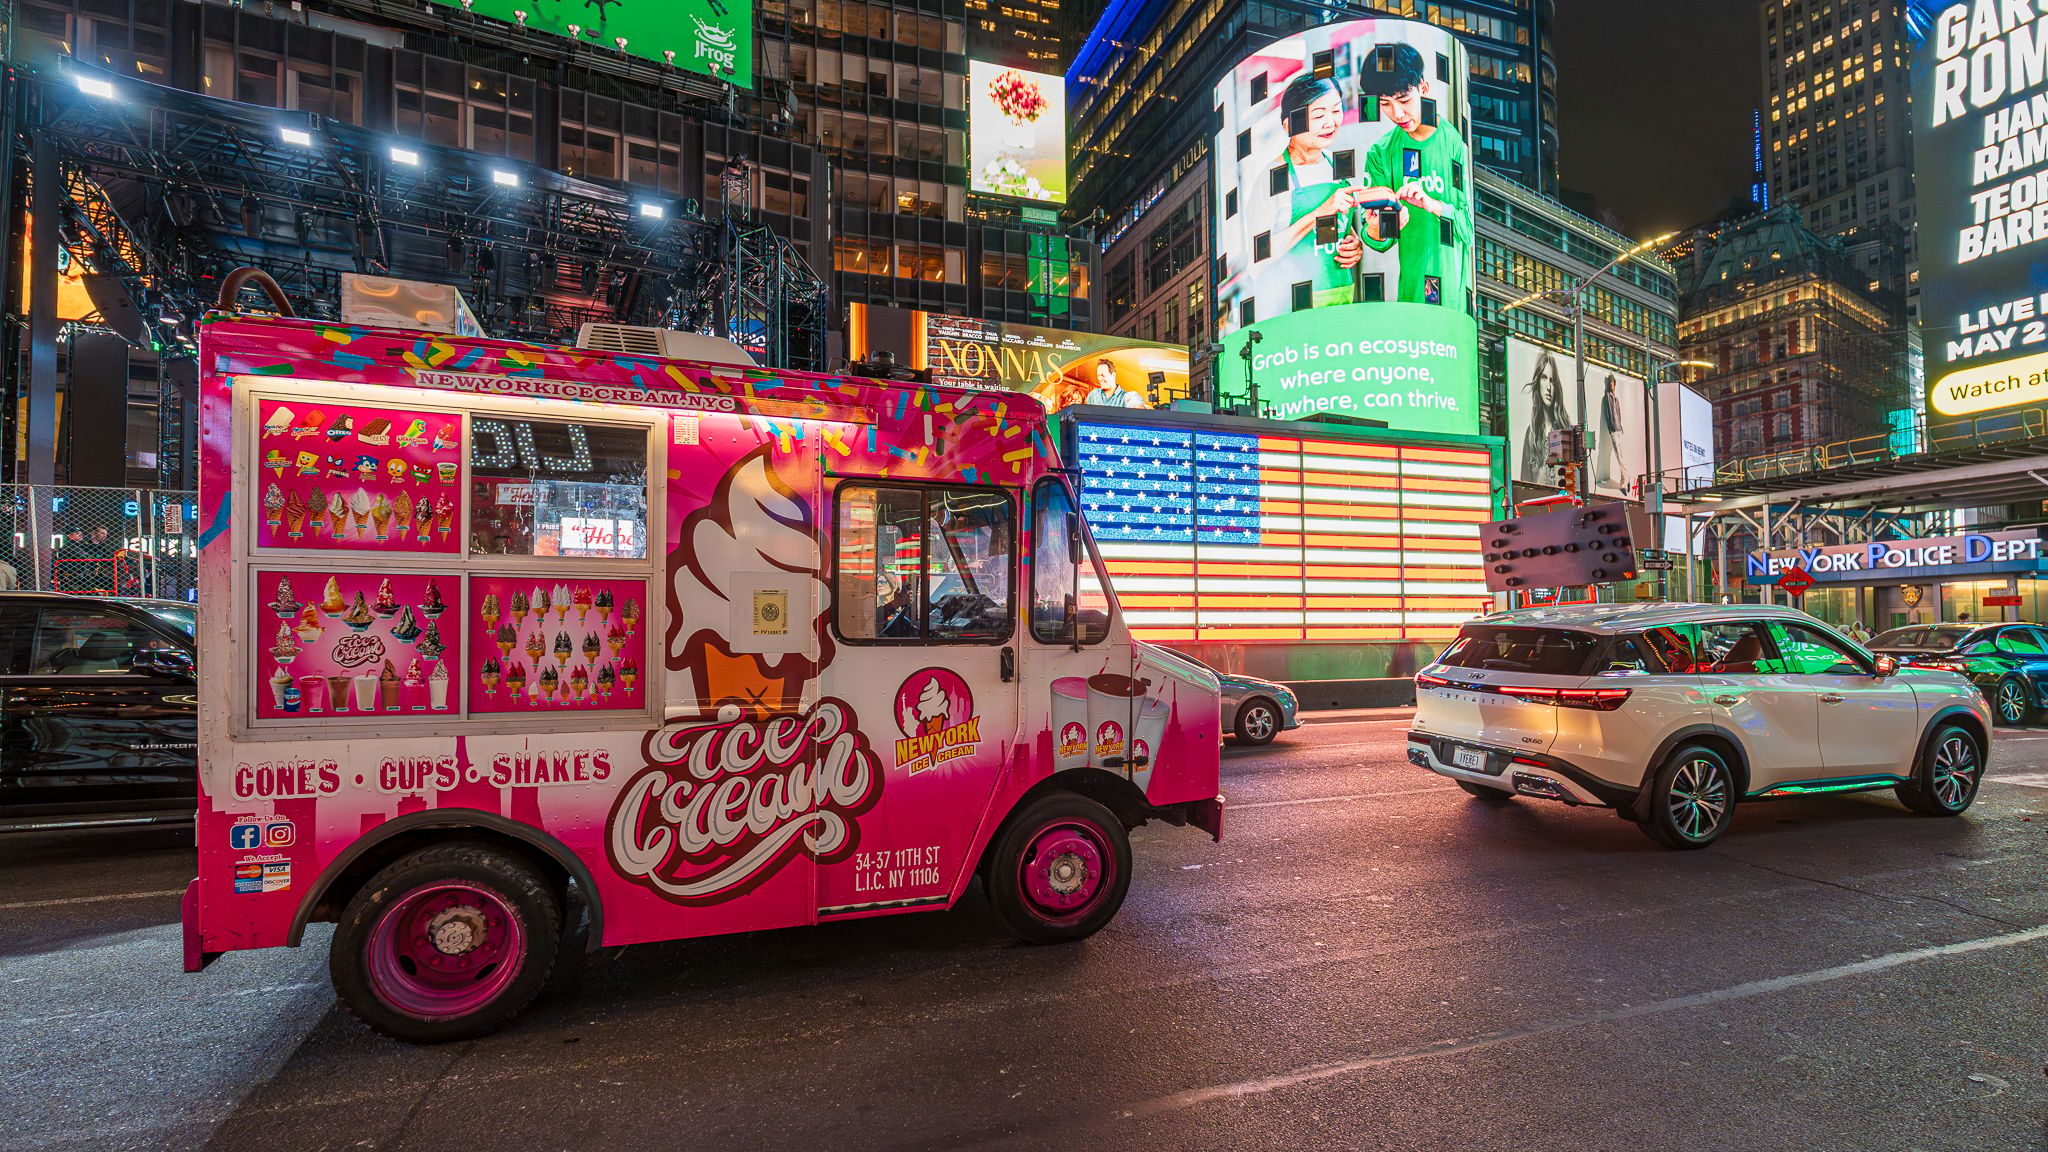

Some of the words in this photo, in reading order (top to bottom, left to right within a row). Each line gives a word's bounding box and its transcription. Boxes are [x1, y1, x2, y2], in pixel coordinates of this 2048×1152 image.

[1936, 0, 2048, 60] GAR
[694, 40, 734, 68] JFrog
[1960, 297, 2034, 334] LIVE
[1252, 346, 1298, 371] Grab
[1304, 343, 1319, 360] is
[1325, 340, 1353, 358] an
[1359, 339, 1457, 359] ecosystem
[1947, 327, 2017, 362] MAY
[2022, 321, 2046, 345] 2
[939, 340, 1064, 385] NONNAS
[418, 372, 733, 409] NEWYORKICECREAM.NYC
[939, 378, 956, 387] Your
[957, 380, 975, 389] table
[1280, 368, 1346, 390] where
[1351, 366, 1435, 385] anyone,
[1950, 375, 2021, 400] Watch
[1258, 392, 1359, 420] nywhere,
[1364, 391, 1402, 408] can
[1407, 389, 1460, 412] thrive.
[165, 506, 173, 532] NATIONAL
[1798, 548, 1861, 573] YORK
[1868, 543, 1953, 569] POLICE
[1965, 535, 2043, 563] DEPT
[1521, 736, 1543, 745] QX60
[911, 758, 930, 773] ICE
[937, 745, 974, 762] CREAM
[235, 758, 340, 799] CONES
[379, 754, 460, 791] CUPS
[492, 748, 611, 786] SHAKES
[257, 854, 282, 862] Accept
[855, 851, 891, 872] 34-37
[895, 848, 920, 868] 11TH
[924, 846, 940, 863] ST
[855, 872, 884, 892] L.I.C.
[889, 869, 904, 888] NY
[910, 866, 939, 886] 11106
